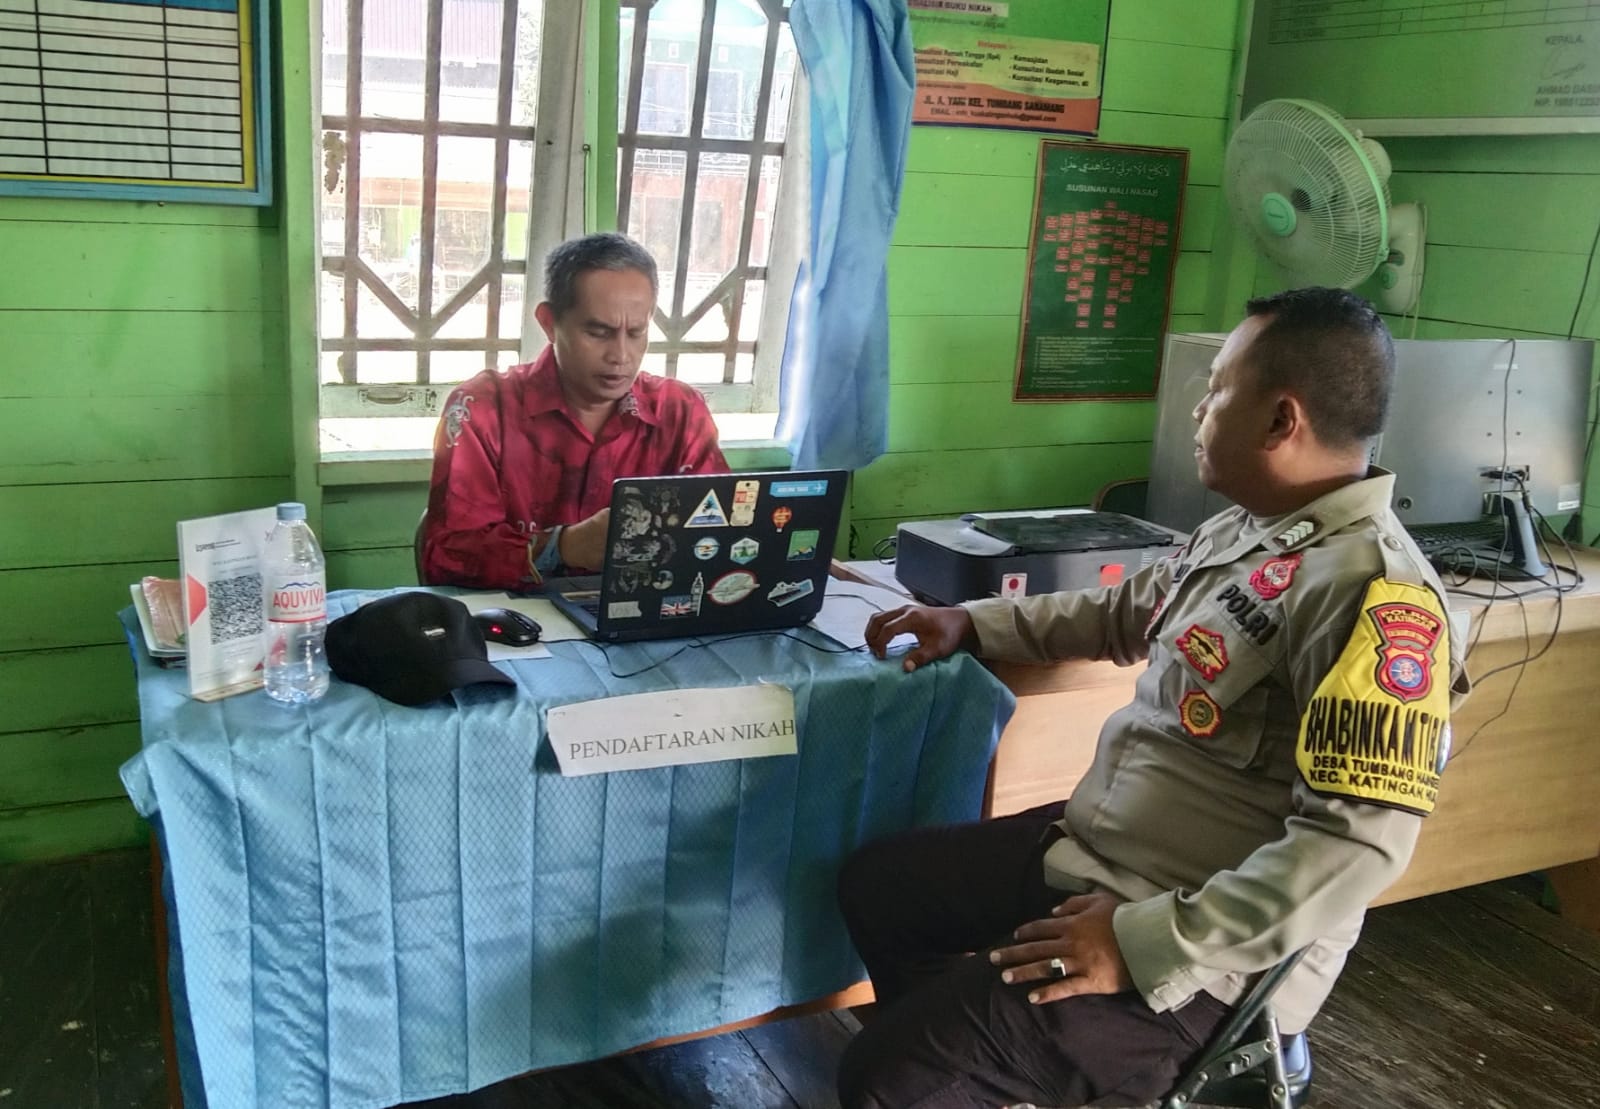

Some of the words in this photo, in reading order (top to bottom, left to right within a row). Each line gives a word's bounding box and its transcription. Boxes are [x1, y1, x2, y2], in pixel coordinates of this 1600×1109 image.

[1065, 183, 1107, 193] SUSUNAN
[1216, 583, 1279, 646] POLRI
[569, 727, 726, 761] PENDAFTARAN
[731, 718, 796, 742] NIKAH
[1313, 755, 1348, 771] DESA
[1352, 758, 1414, 781] TUMBANG
[1309, 769, 1343, 784] KEC.
[1349, 773, 1424, 798] KATINGAN
